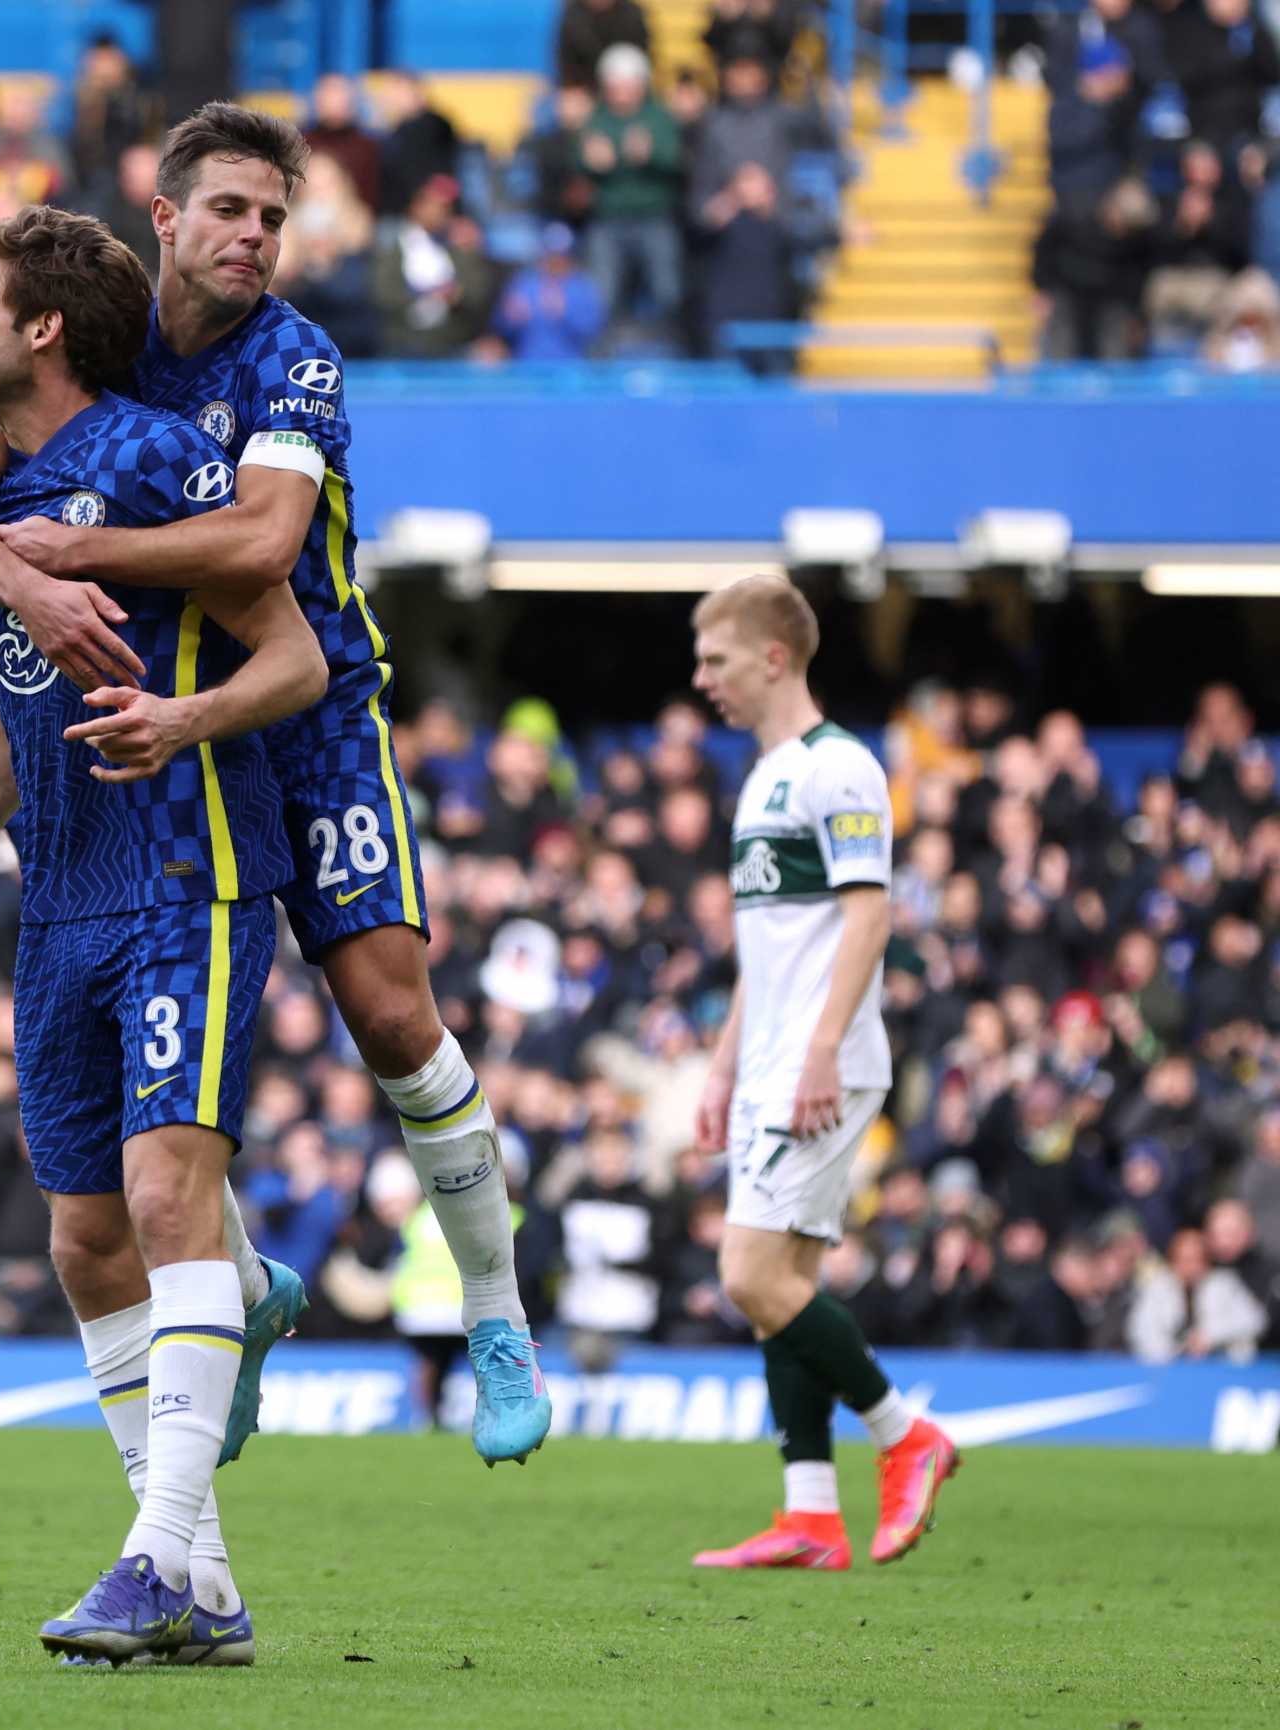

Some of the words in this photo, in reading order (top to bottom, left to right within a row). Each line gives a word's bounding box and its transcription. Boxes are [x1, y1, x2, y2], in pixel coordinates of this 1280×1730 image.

[270, 398, 336, 420] HYUNDA
[308, 805, 389, 890] 28
[144, 995, 182, 1070] 3
[434, 1162, 489, 1184] CFC
[152, 1394, 191, 1406] CFC
[260, 1370, 406, 1436] IKE
[1207, 1386, 1280, 1453] N
[121, 1448, 138, 1458] FC
